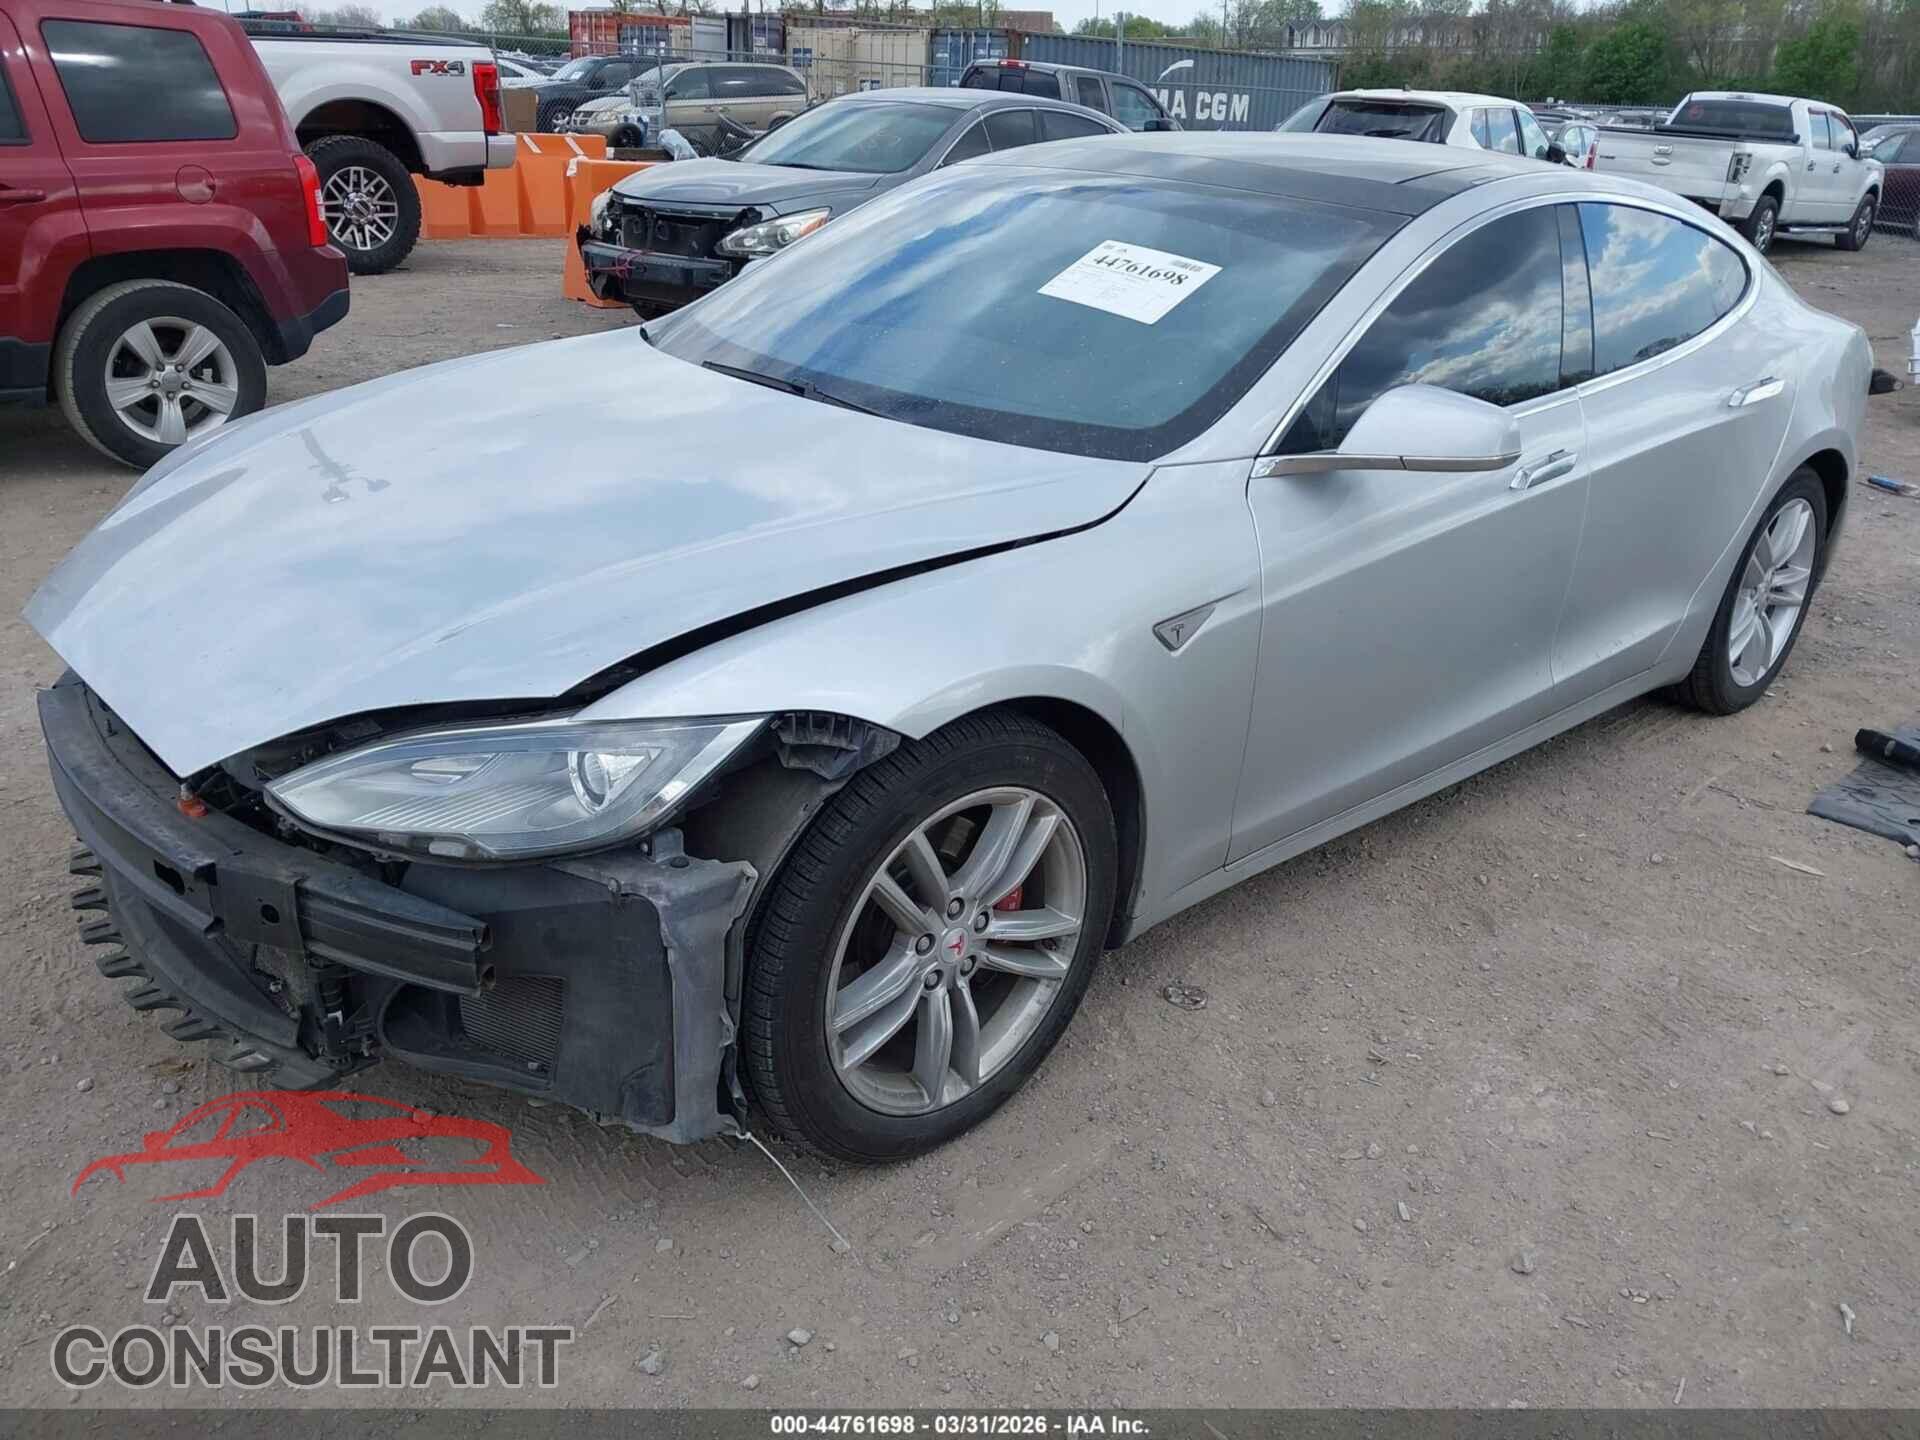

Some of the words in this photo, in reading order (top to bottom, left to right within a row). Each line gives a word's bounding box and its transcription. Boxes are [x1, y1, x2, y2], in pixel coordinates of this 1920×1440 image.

[410, 60, 465, 75] FX4
[1195, 91, 1250, 122] CGM
[1094, 255, 1189, 285] 44761698
